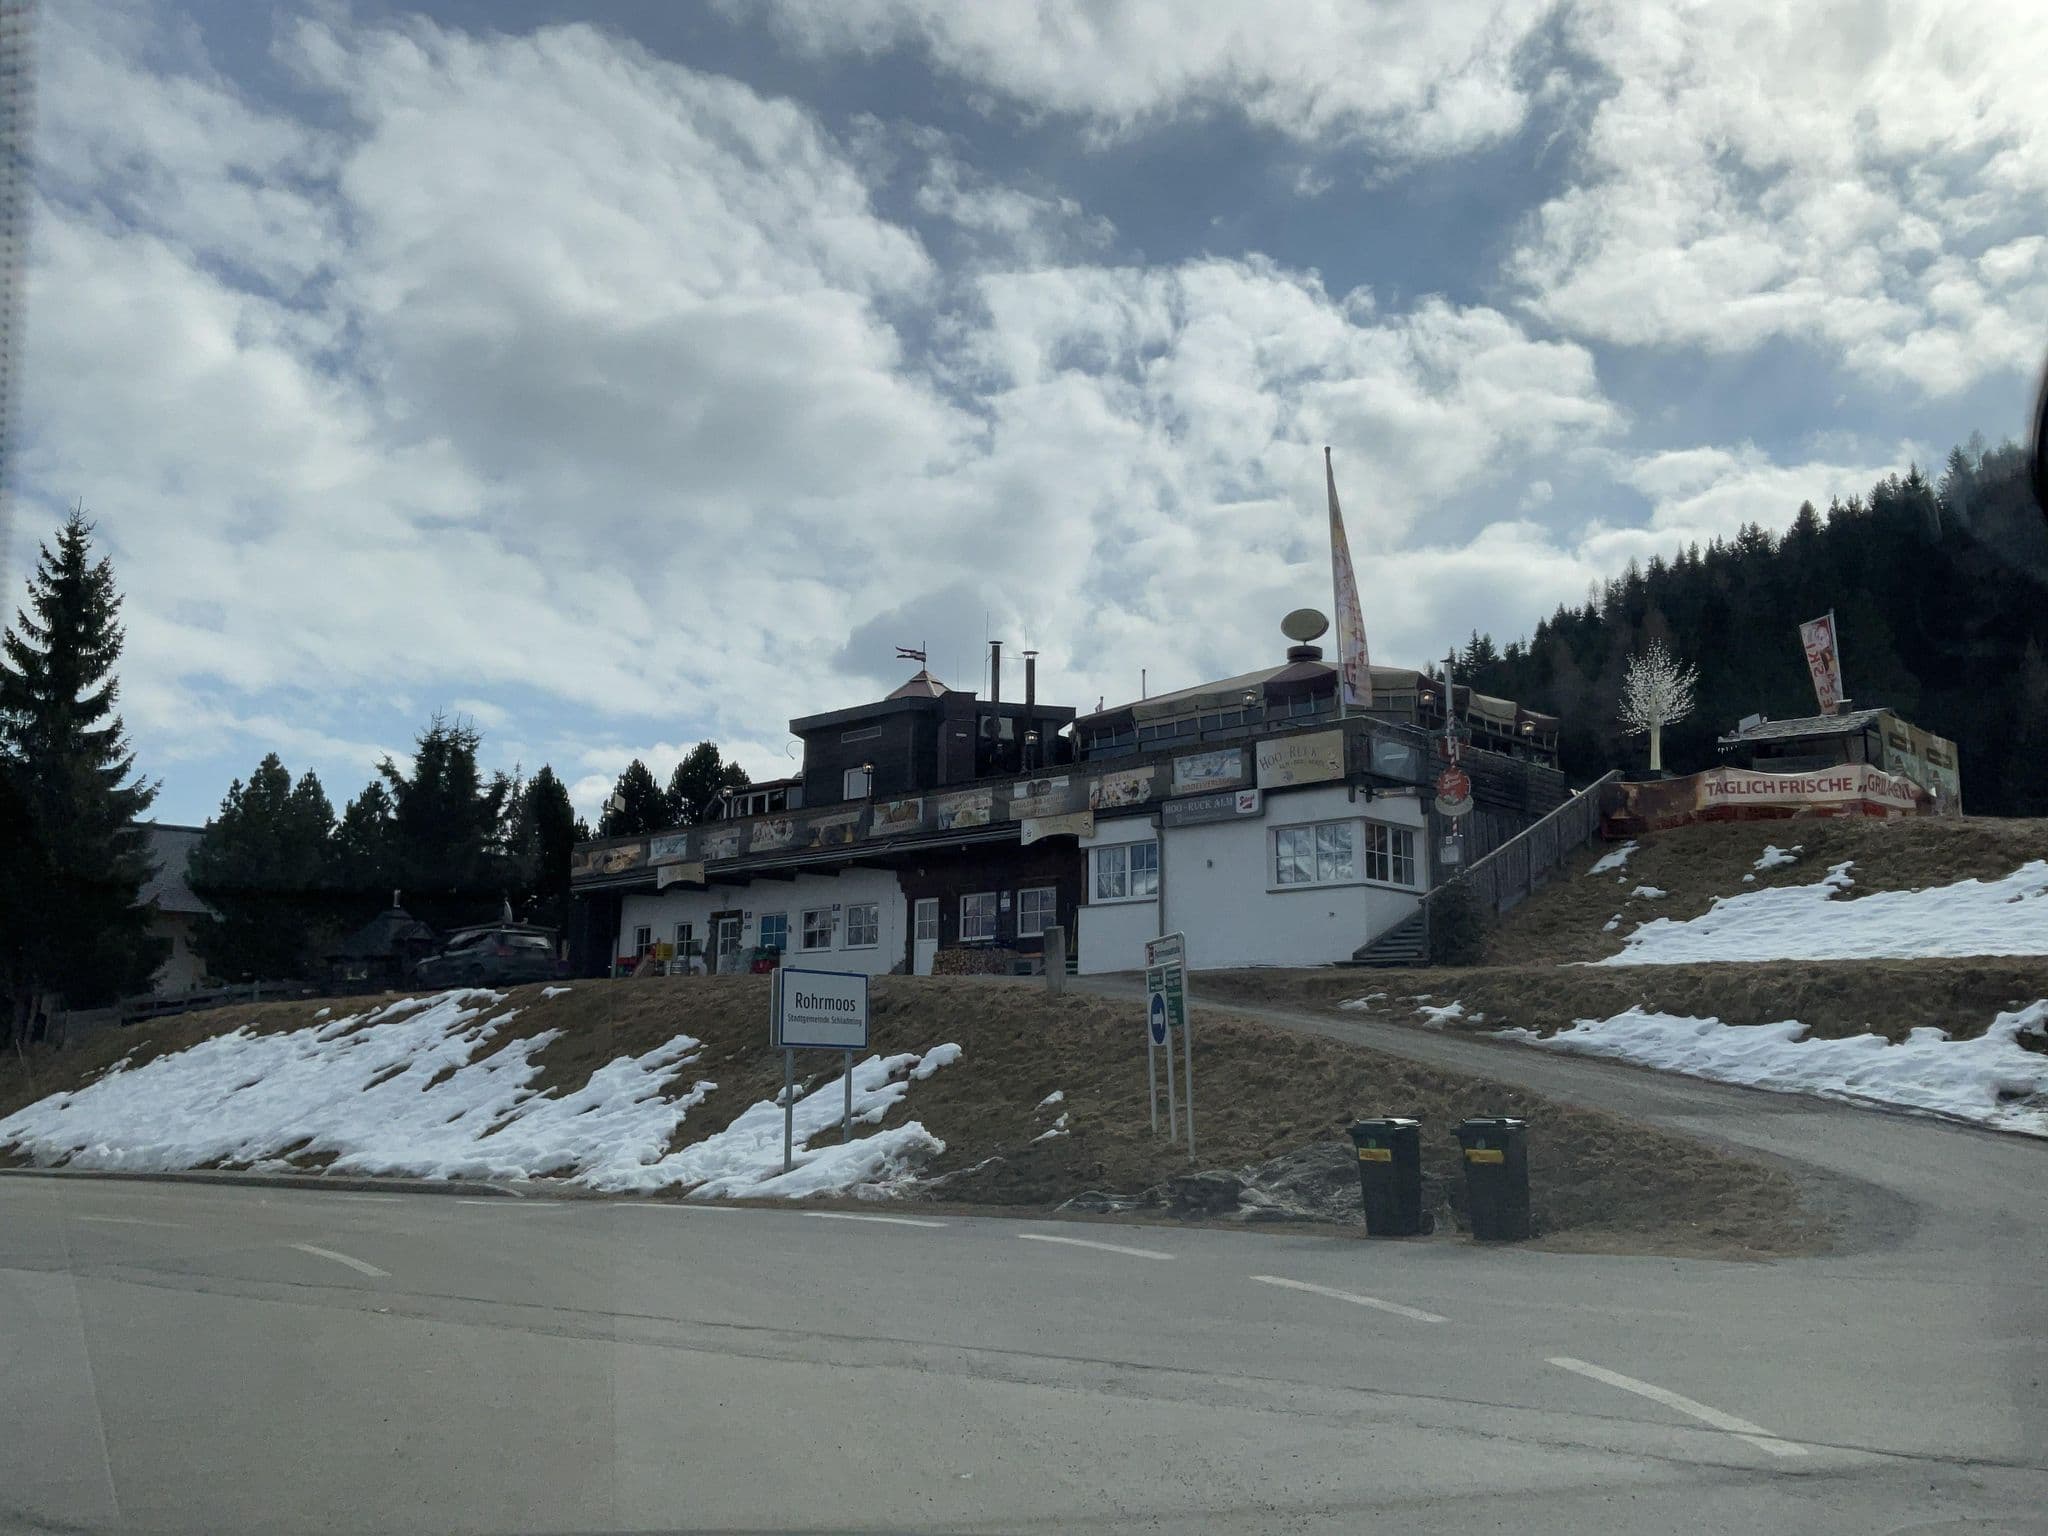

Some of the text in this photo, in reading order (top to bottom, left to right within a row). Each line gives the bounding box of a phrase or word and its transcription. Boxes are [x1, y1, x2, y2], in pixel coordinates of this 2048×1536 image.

[1779, 777, 1853, 794] FRISCHE
[795, 991, 856, 1012] Rohrmoos
[787, 1013, 863, 1028] Stadtgemeinde Schladming
